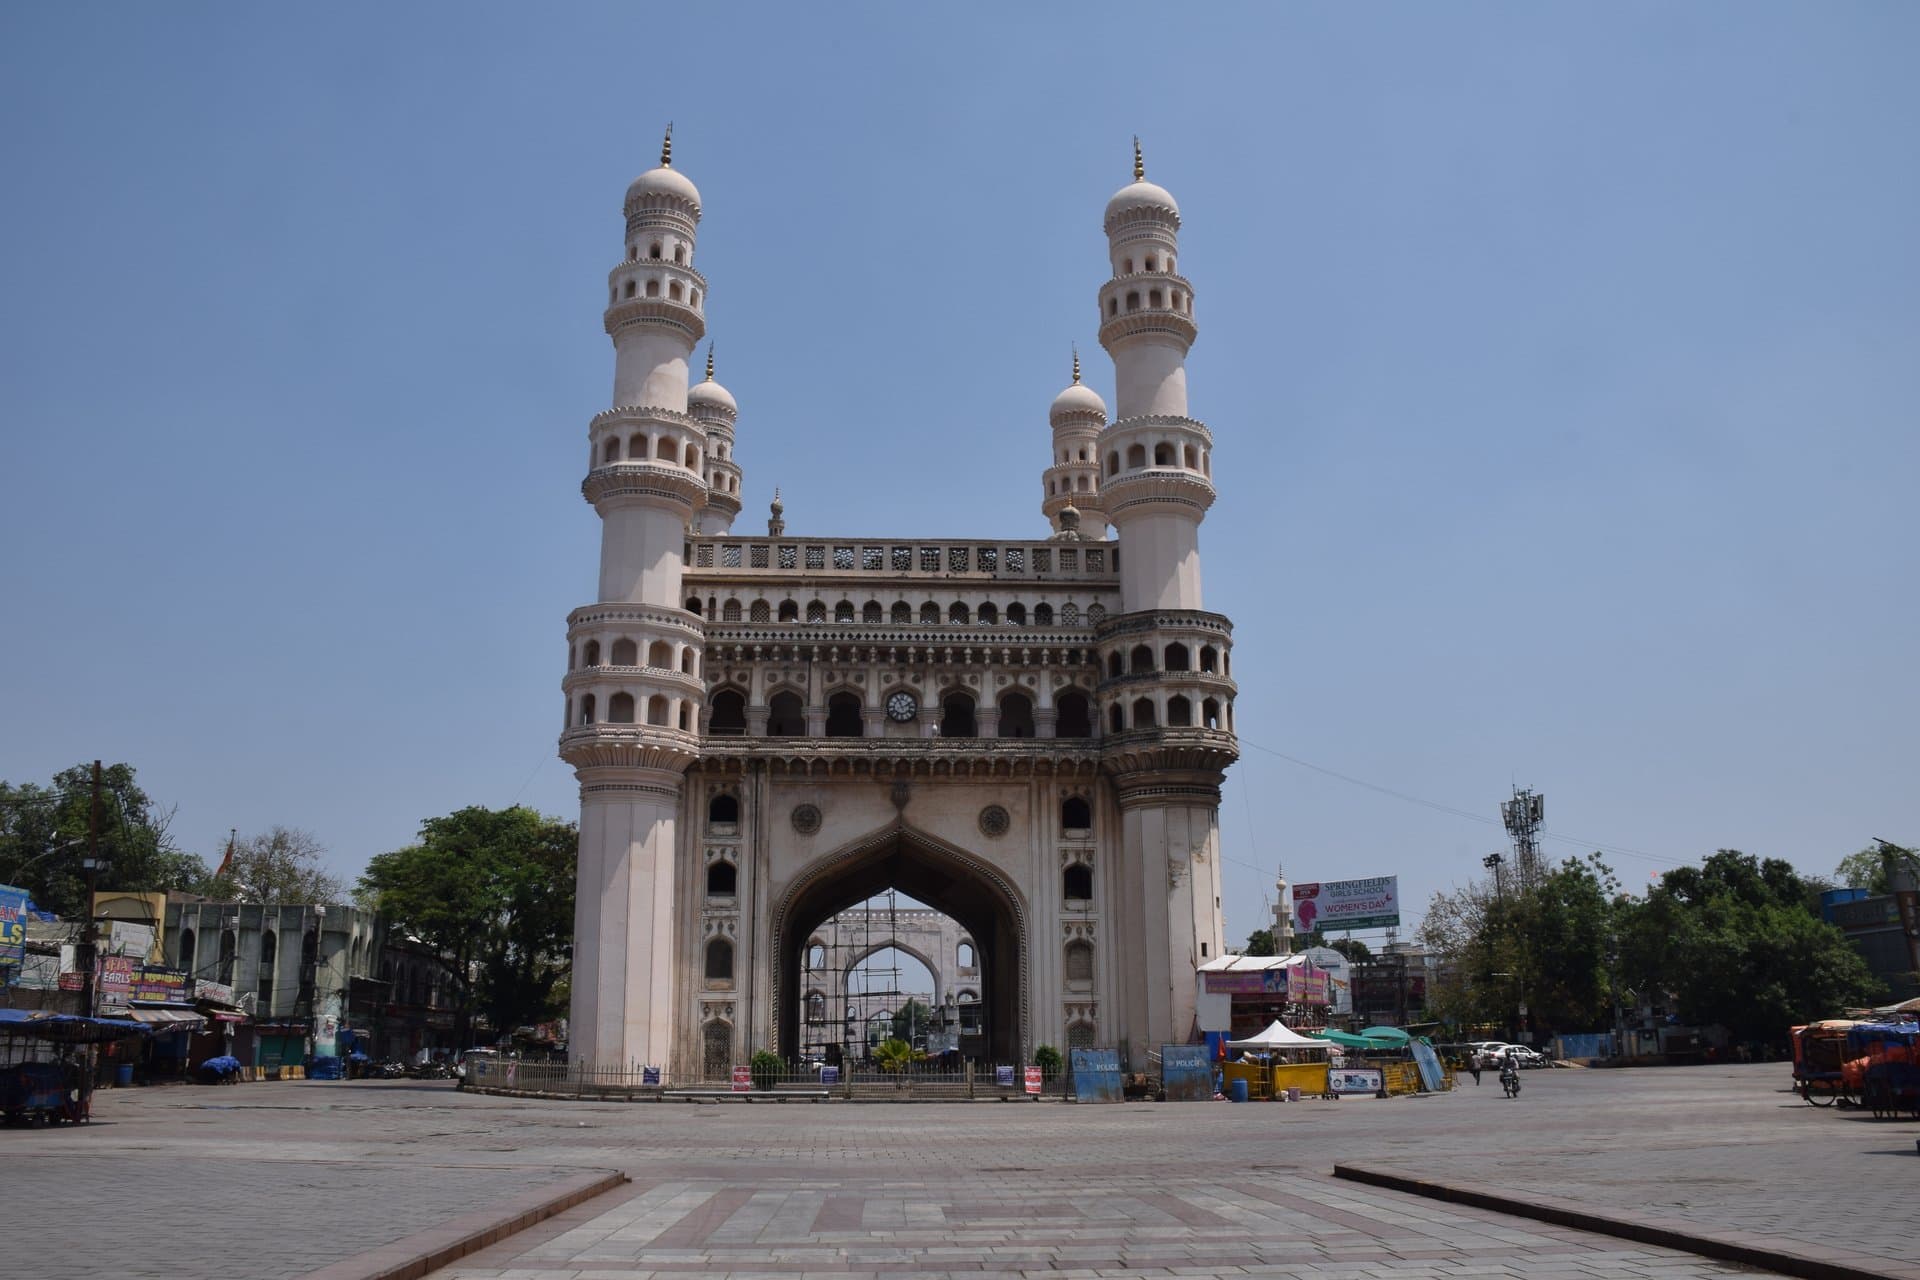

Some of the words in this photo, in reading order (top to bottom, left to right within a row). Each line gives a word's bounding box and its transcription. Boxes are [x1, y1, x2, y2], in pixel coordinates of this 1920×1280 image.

[1325, 877, 1390, 891] SPRINGFIELDS
[1330, 889, 1351, 897] GIRLS
[1354, 886, 1385, 896] SCHOOL
[1325, 902, 1367, 913] WOMEN'S
[1369, 899, 1386, 910] DAY
[1096, 1063, 1119, 1071] POLICE
[1175, 1060, 1200, 1068] POLICE
